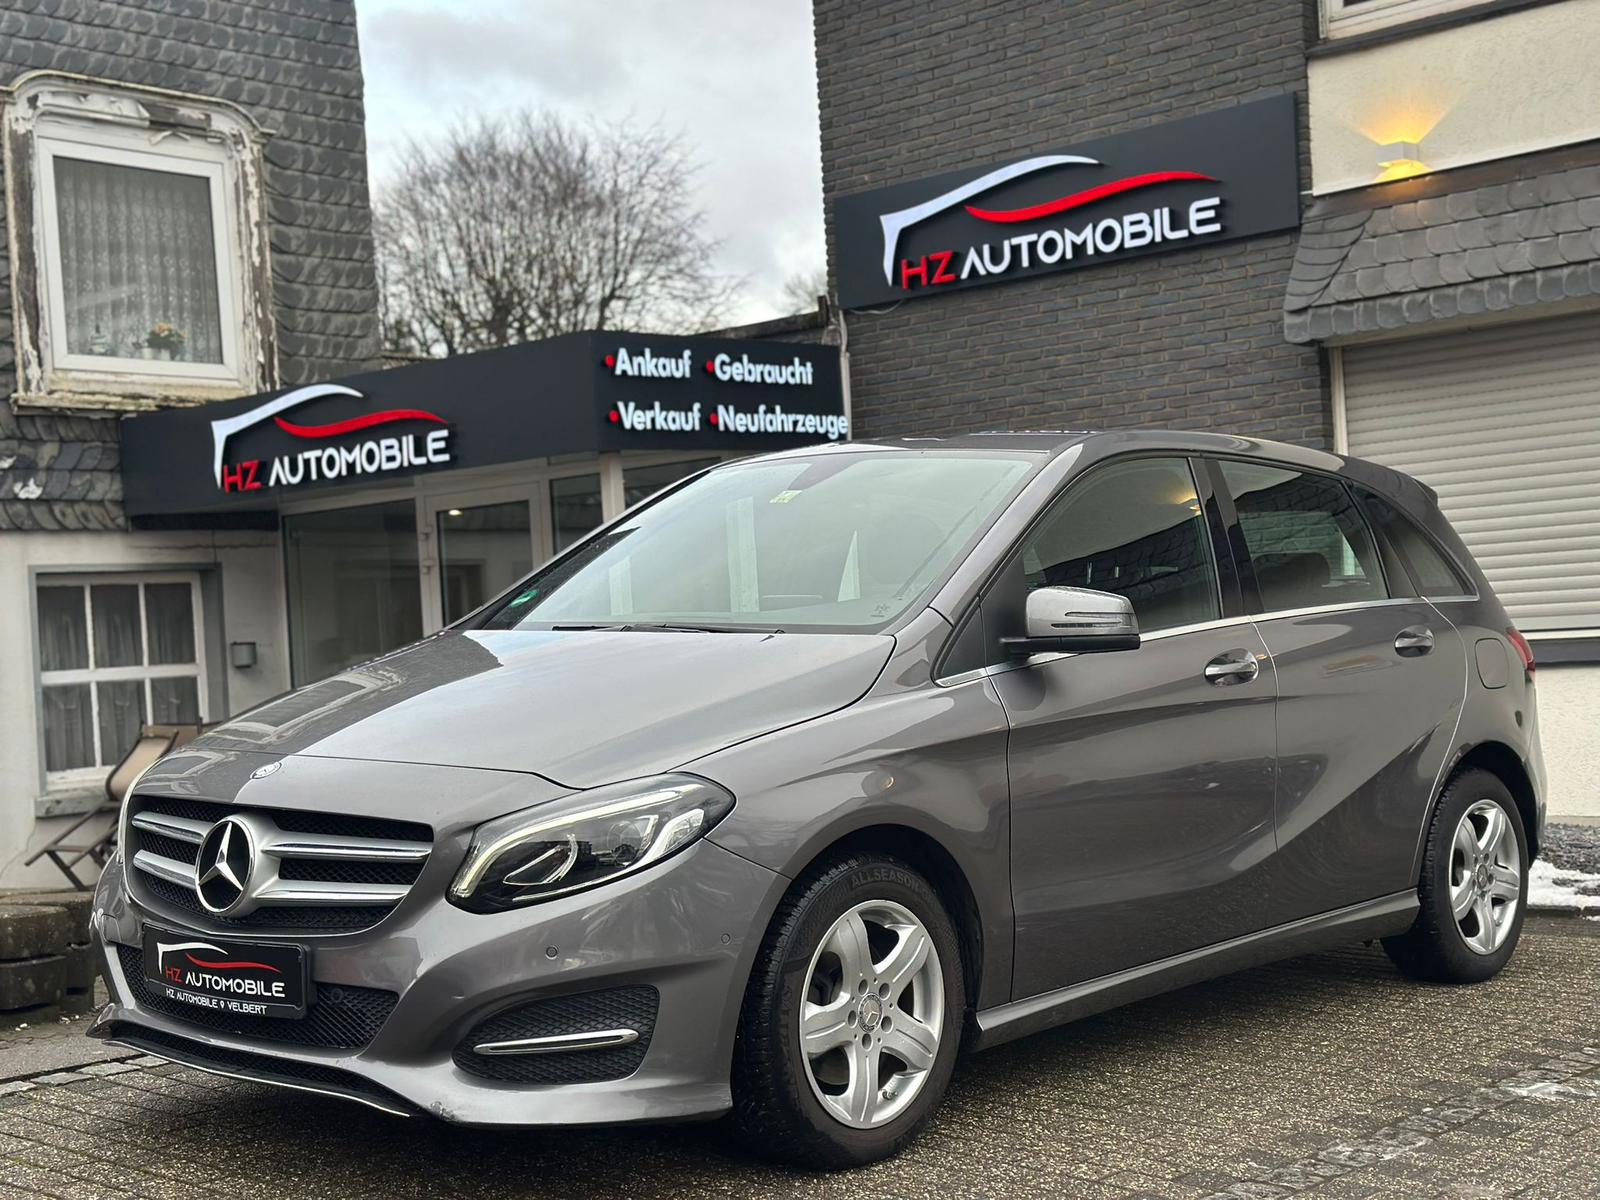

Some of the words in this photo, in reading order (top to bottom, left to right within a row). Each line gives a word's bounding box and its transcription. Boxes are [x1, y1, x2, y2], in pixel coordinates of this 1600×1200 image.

[901, 251, 956, 290] HZ
[960, 197, 1221, 280] AUTOMOBILE
[614, 347, 692, 378] Ankauf
[714, 353, 813, 385] Gebraucht
[617, 401, 701, 431] Verkauf
[717, 404, 849, 440] Neufahrzeuge
[223, 460, 263, 494] HZ
[269, 429, 450, 487] AUTOMOBILE
[165, 965, 183, 983] HZ
[185, 971, 286, 998] AUTOMOBILE
[166, 988, 175, 999] HZ
[176, 991, 218, 1009] AUTOMOBILE
[228, 1001, 267, 1015] VELBERT
